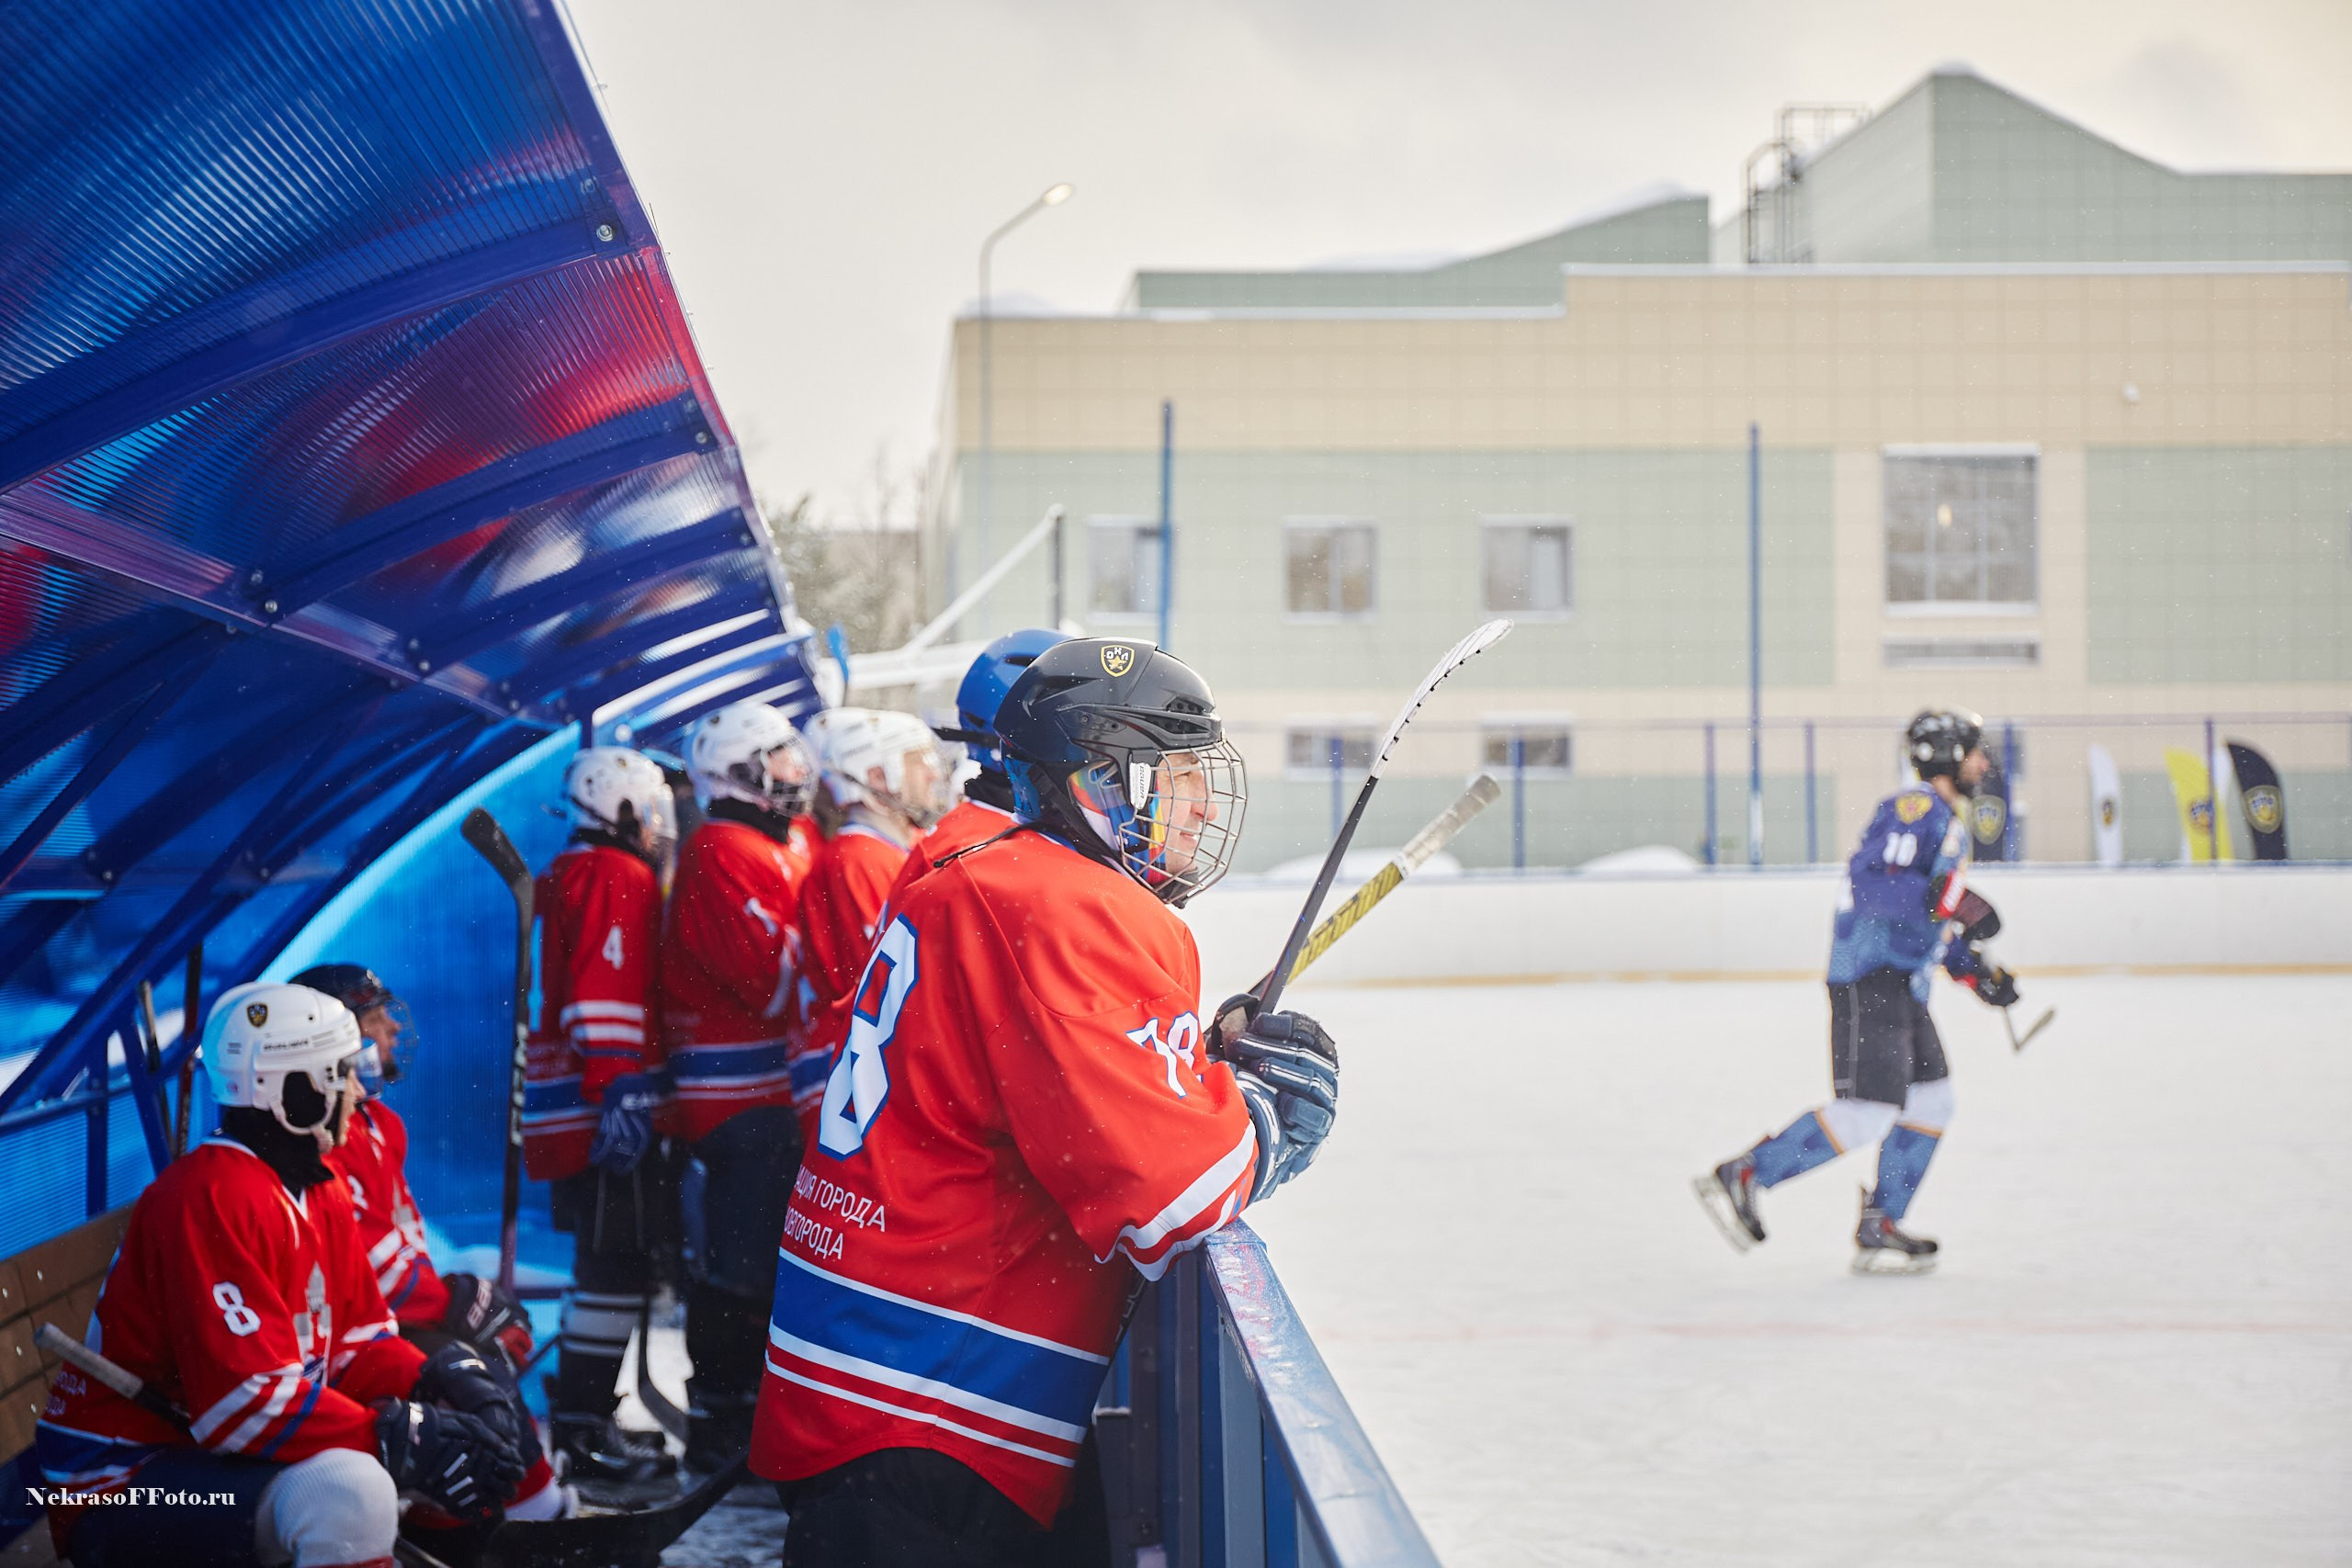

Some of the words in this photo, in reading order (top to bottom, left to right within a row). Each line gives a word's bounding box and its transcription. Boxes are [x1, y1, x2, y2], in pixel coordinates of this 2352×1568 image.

[602, 925, 624, 971] 4
[817, 909, 920, 1162] 8
[1125, 1010, 1204, 1100] 78
[813, 1179, 886, 1233] ГОРОДА
[212, 1280, 262, 1337] 8
